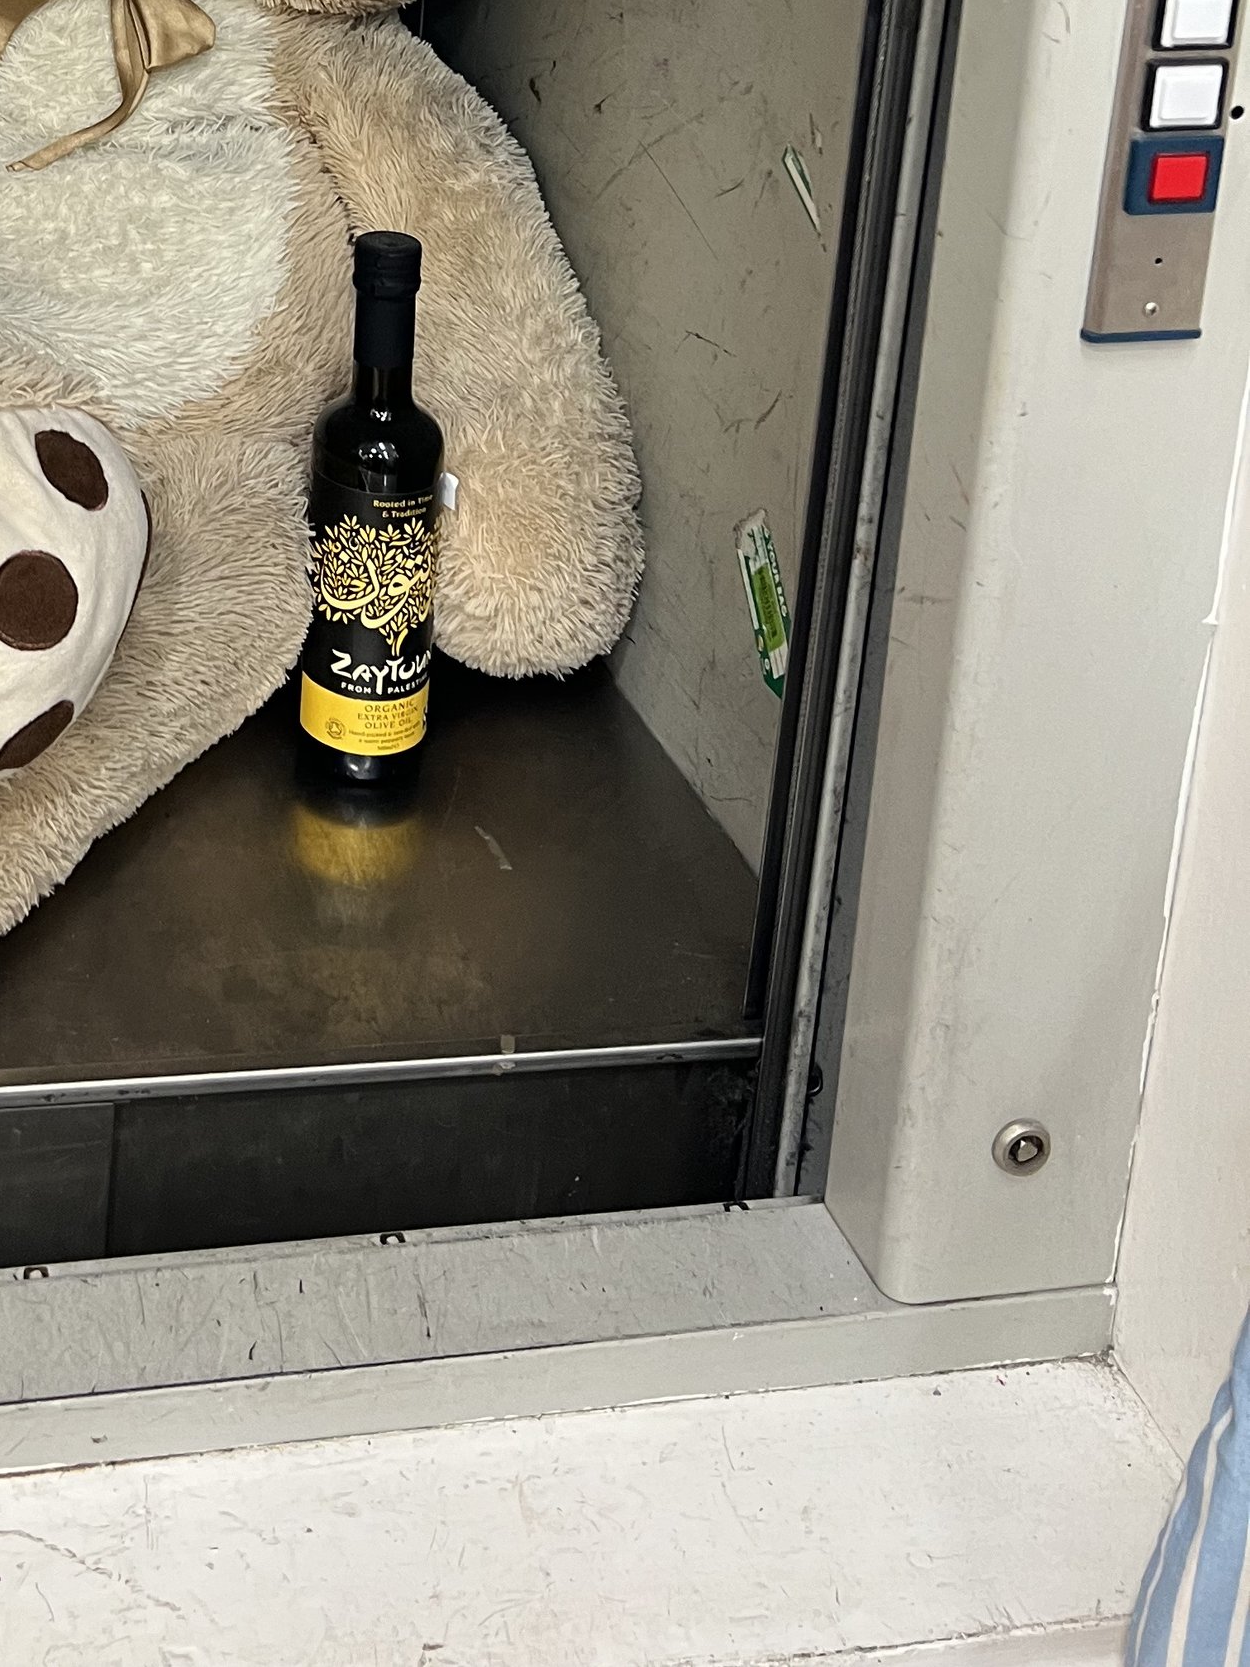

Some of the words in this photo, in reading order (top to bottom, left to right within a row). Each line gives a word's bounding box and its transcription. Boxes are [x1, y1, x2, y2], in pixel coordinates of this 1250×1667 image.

[373, 499, 406, 508] Rooted
[382, 510, 389, 518] &
[777, 586, 787, 617] BAG
[341, 681, 372, 694] FROM
[364, 699, 414, 713] ORGANIC
[358, 713, 389, 721] EXTRA
[364, 721, 396, 729] OLIVE
[398, 718, 411, 727] OIL
